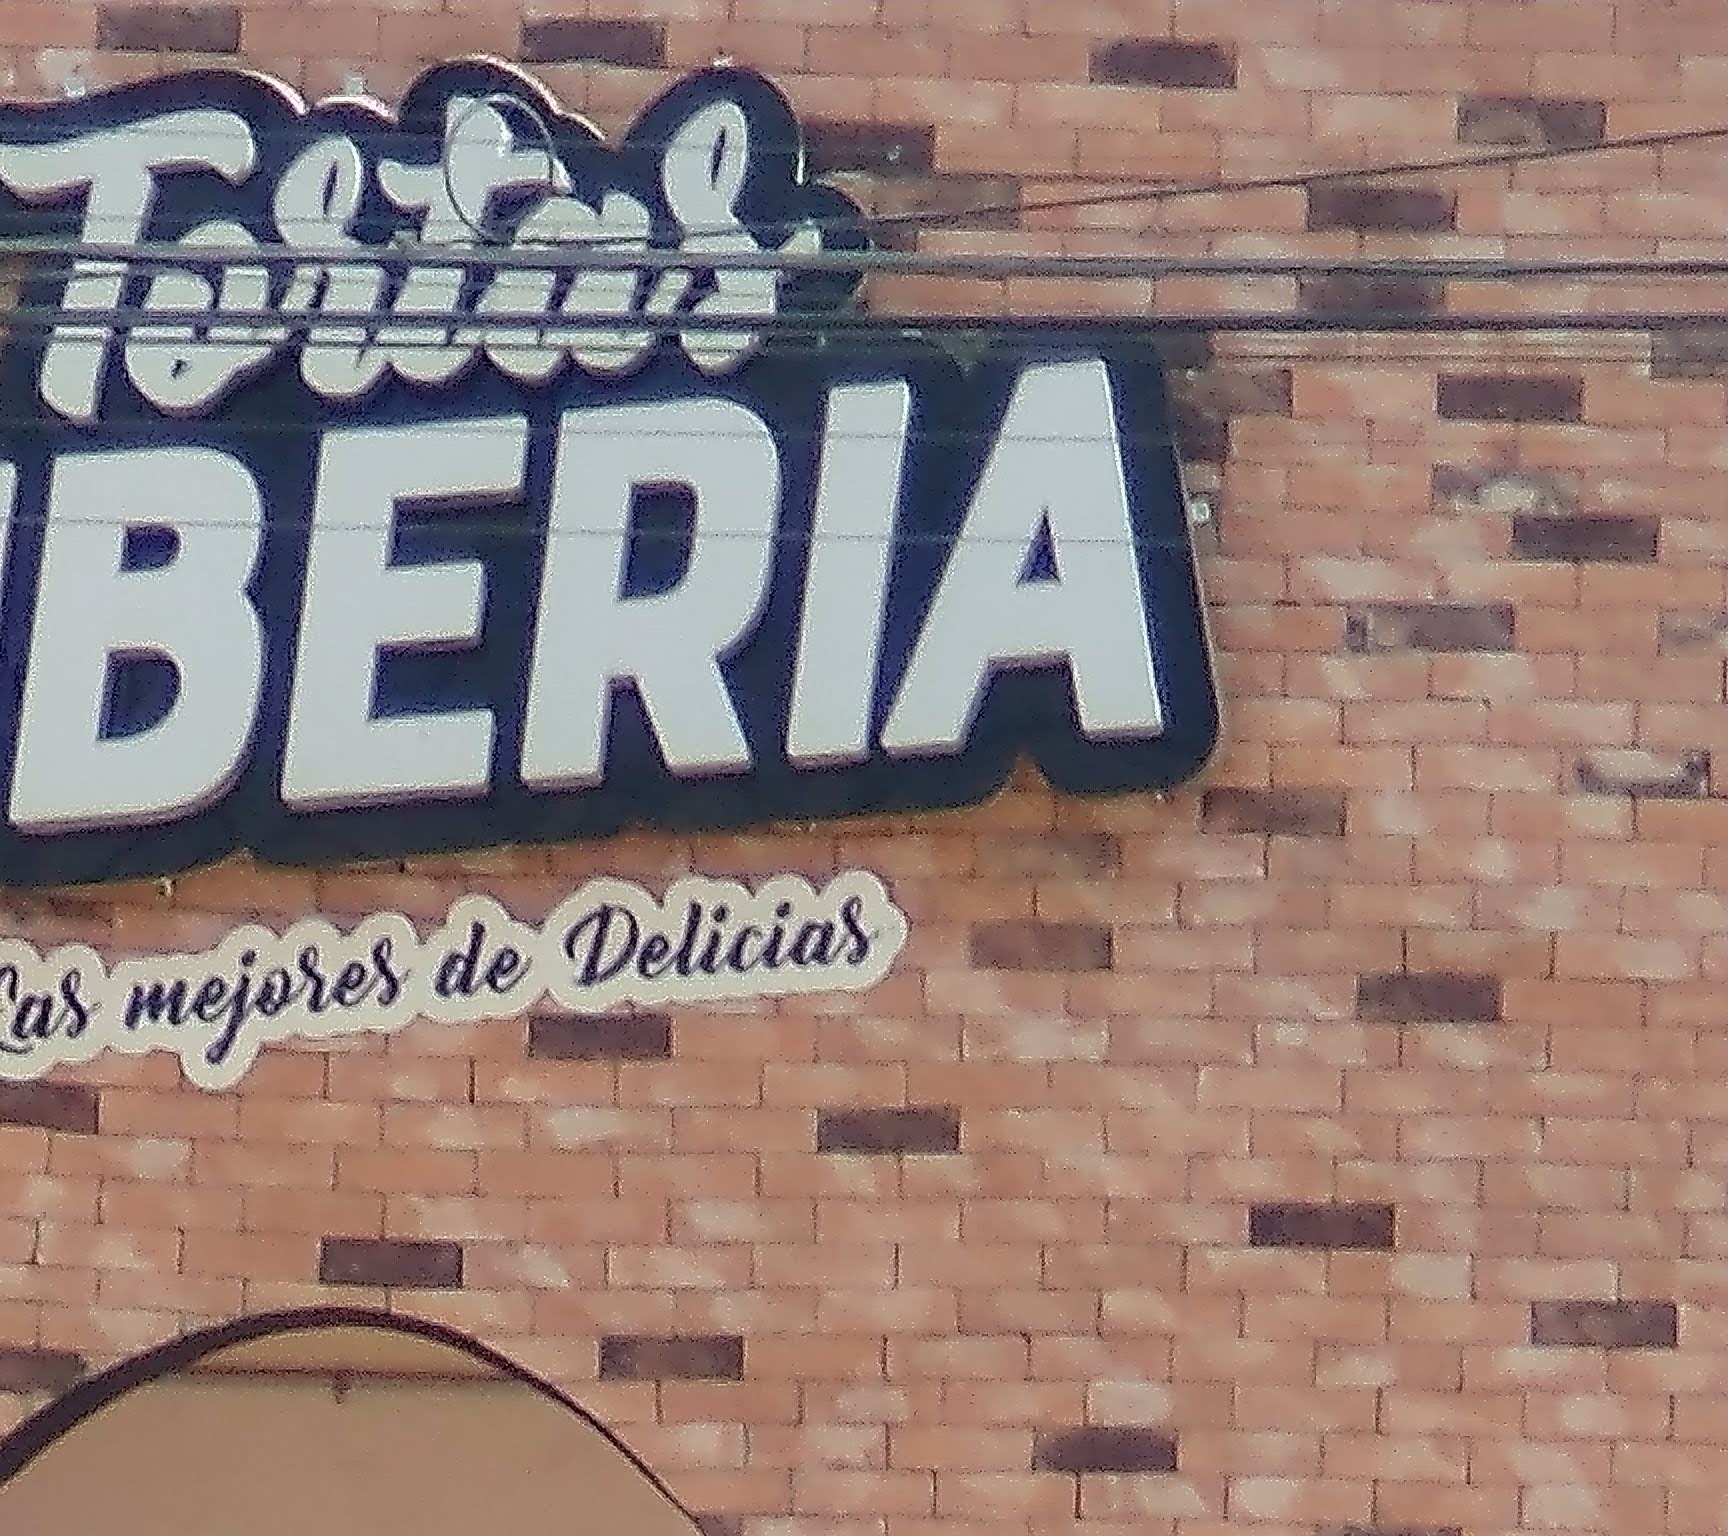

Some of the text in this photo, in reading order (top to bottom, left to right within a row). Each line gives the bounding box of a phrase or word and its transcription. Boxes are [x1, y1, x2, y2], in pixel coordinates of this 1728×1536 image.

[124, 934, 410, 1067] mejores
[435, 920, 532, 999] de
[563, 893, 880, 989] Delicias
